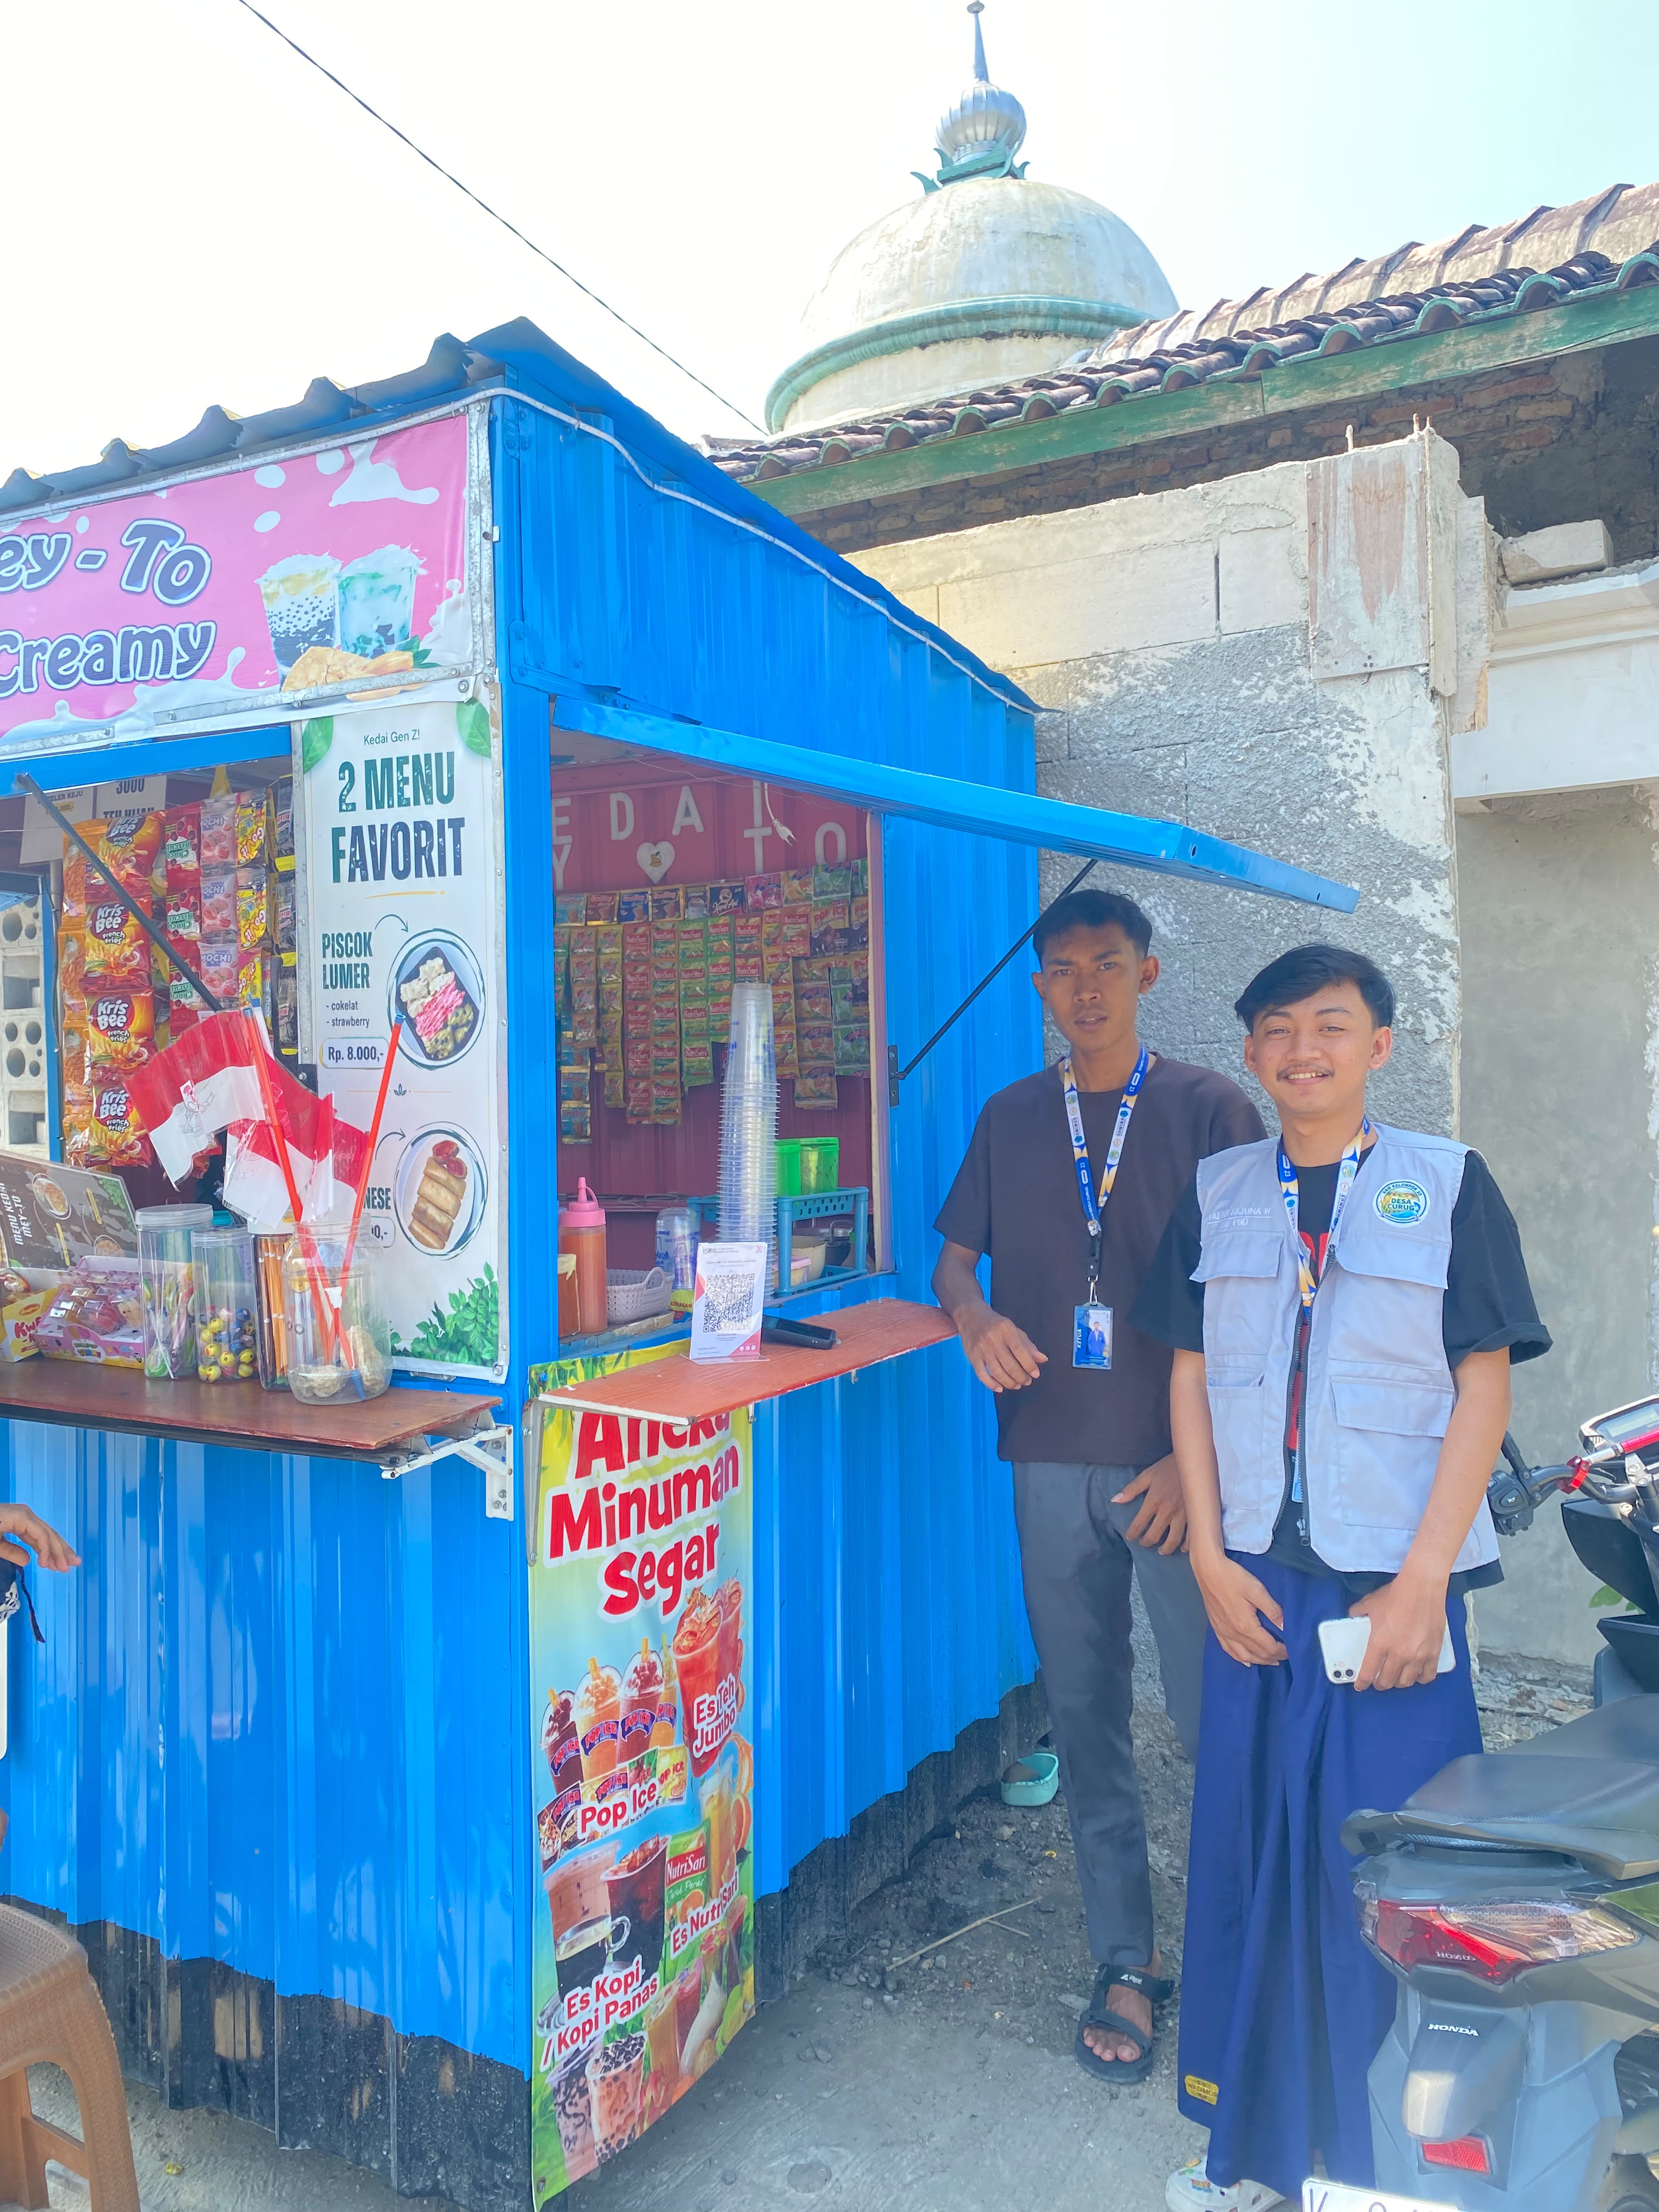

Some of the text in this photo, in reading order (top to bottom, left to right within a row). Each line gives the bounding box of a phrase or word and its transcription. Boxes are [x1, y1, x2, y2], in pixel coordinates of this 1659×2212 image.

[120, 519, 212, 606] To
[0, 620, 217, 698] Creamy
[364, 729, 420, 746] Kedai Gen Z!
[338, 751, 455, 813] 2 MENU
[201, 816, 224, 827] OCHI
[166, 840, 191, 851] Biscui
[331, 817, 465, 884] FAVORIT
[201, 885, 225, 895] OCHI
[97, 904, 125, 920] Kris
[168, 911, 193, 922] Biscui
[96, 917, 121, 933] Bee
[321, 932, 374, 959] PISCOK
[322, 963, 371, 990] LUMER
[98, 999, 129, 1015] Kris
[331, 1000, 358, 1011] cokelat
[97, 1014, 127, 1031] Bee
[331, 1017, 370, 1029] strawberry
[328, 1046, 384, 1062] Rp. 8.000,-
[101, 1089, 128, 1104] Kris
[100, 1103, 127, 1119] Bee
[364, 1187, 391, 1210] NESE
[549, 1445, 739, 1560] Minuman
[603, 1523, 719, 1616] Segar
[697, 1678, 735, 1725] Es Teh
[695, 1706, 736, 1753] Jumbo
[581, 1800, 628, 1834] Pop
[632, 1782, 657, 1814] Ice
[667, 1853, 706, 1883] NutriSari
[673, 1871, 738, 1954] Es NutriSari
[567, 1960, 640, 2020] Es Kopi
[557, 2007, 599, 2056] Kopi
[605, 1977, 658, 2025] Panas
[1427, 2023, 1480, 2038] HONDA
